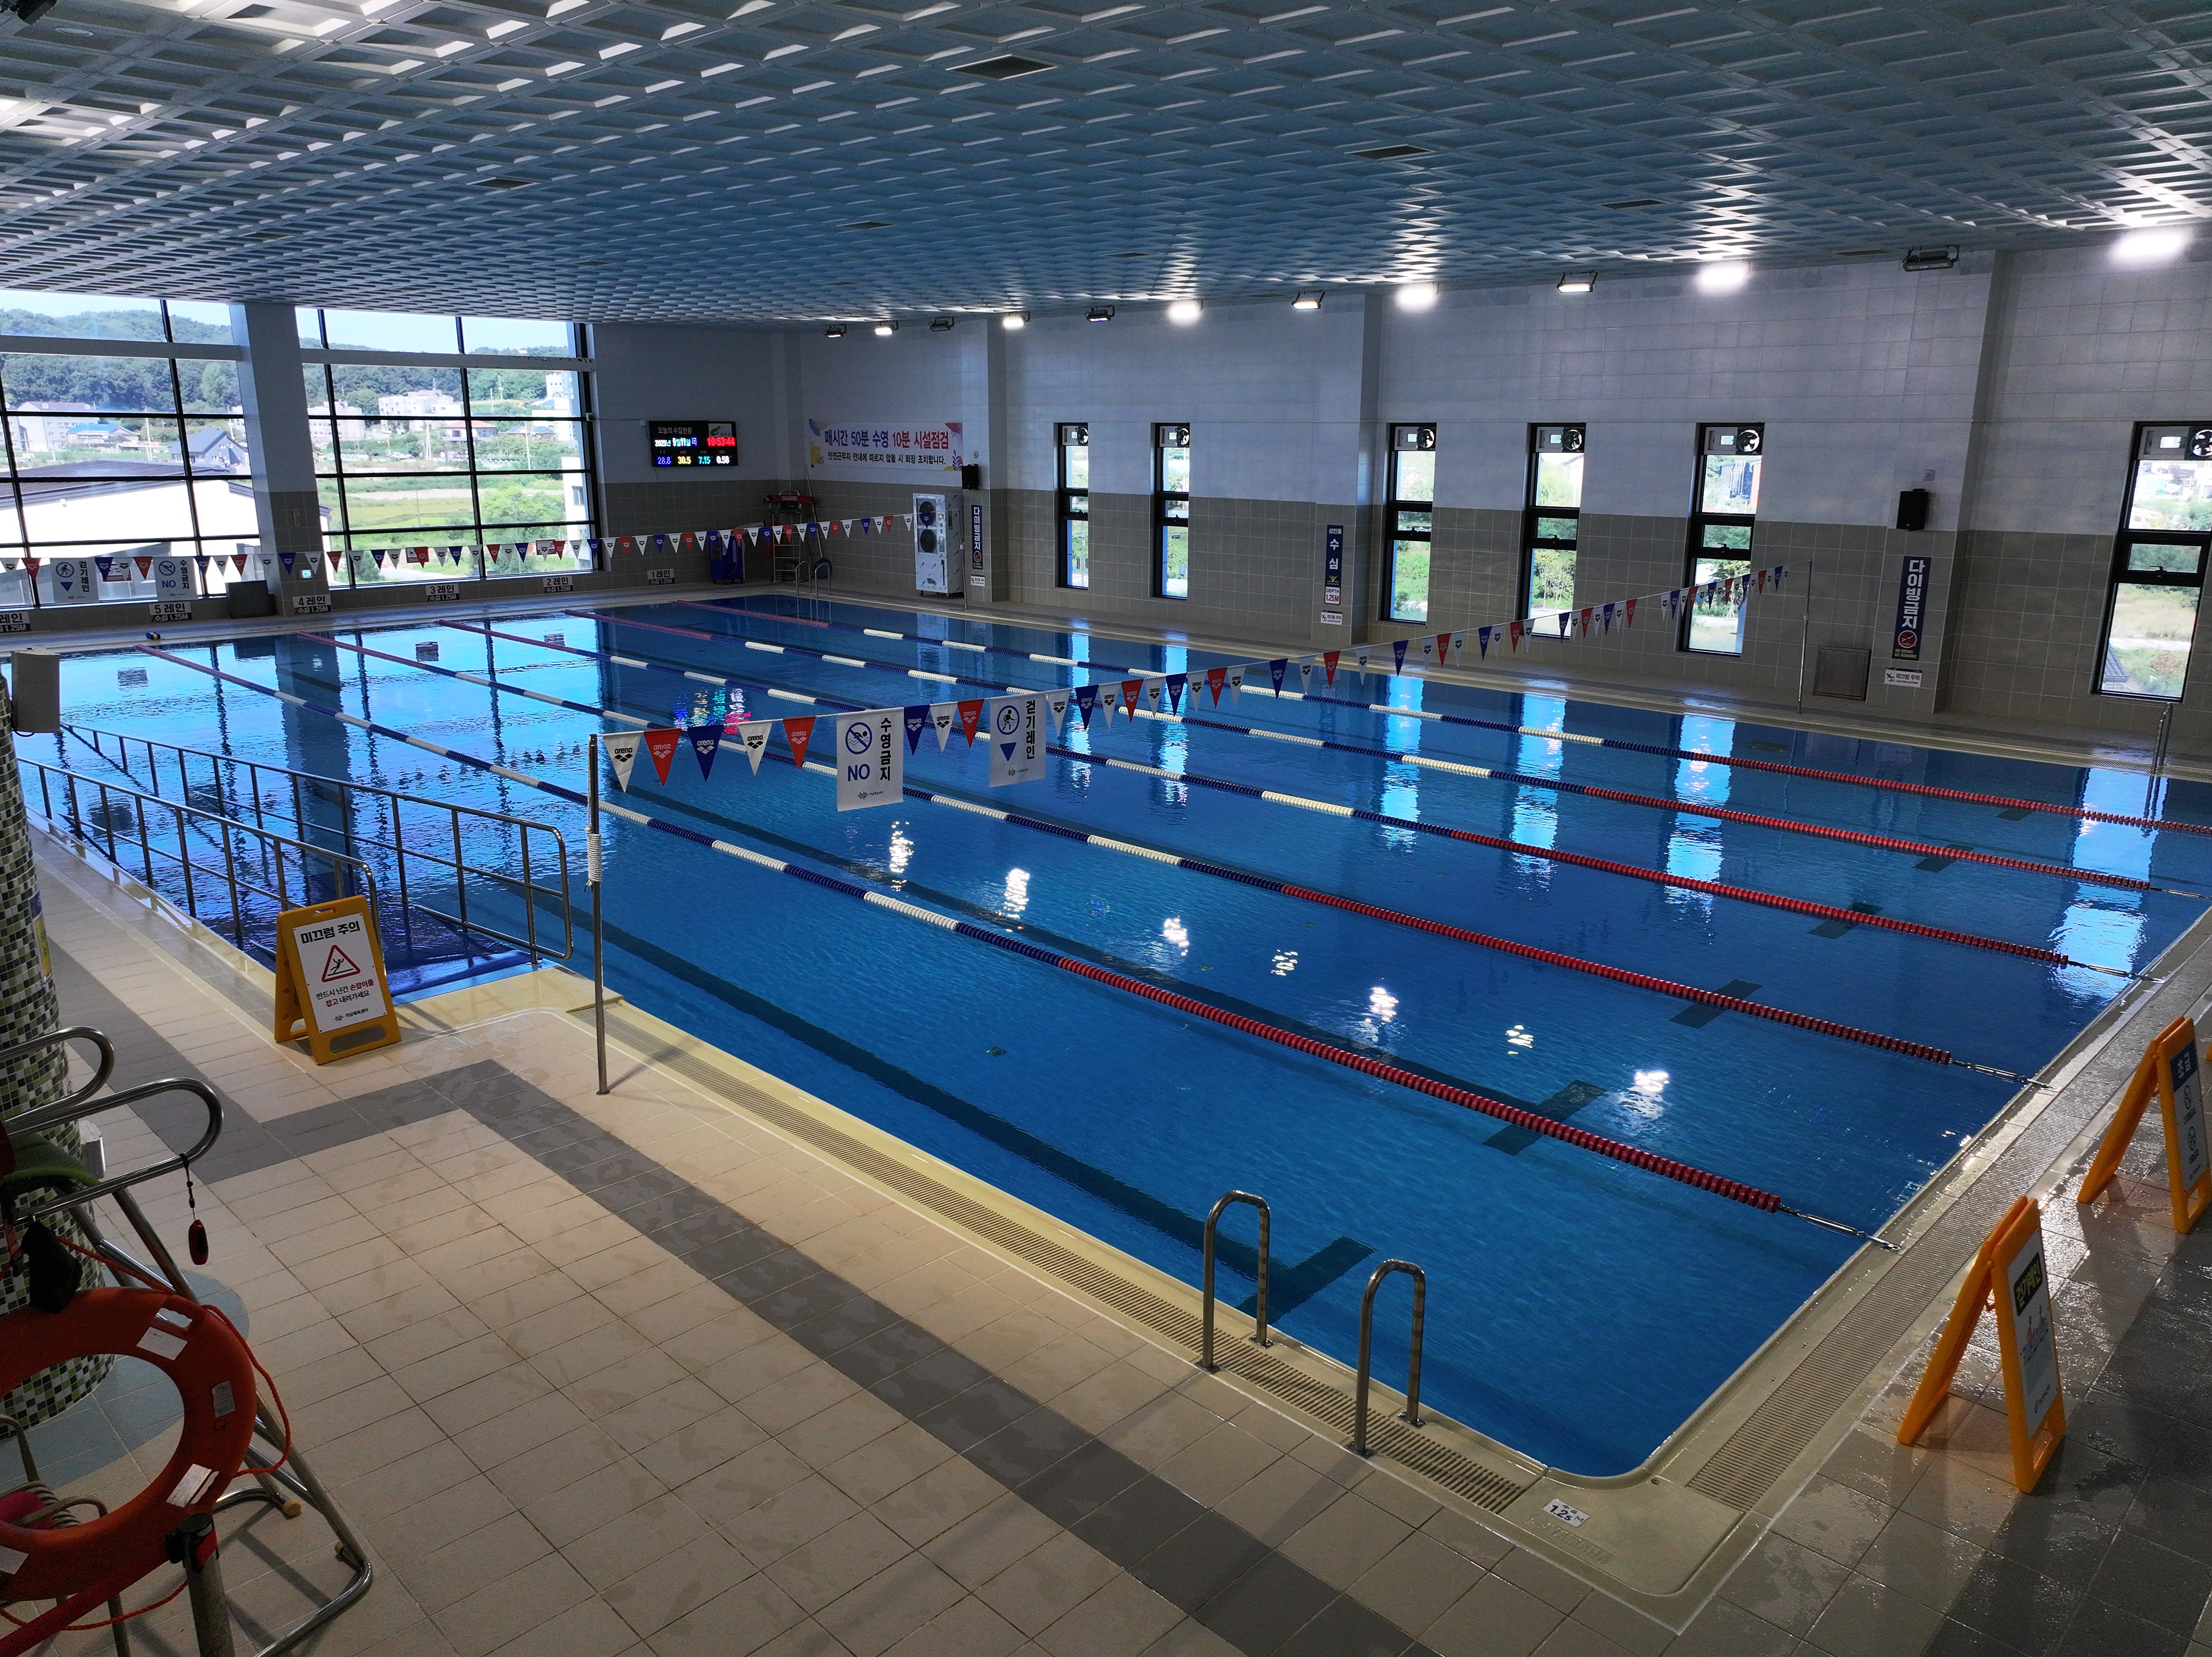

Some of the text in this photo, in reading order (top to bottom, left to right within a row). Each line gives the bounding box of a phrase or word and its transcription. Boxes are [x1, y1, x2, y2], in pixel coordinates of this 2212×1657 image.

[707, 437, 735, 447] 10:53:44
[824, 429, 949, 449] 매시간 50분 수영 10분 시설점검
[677, 456, 691, 464] 30.5
[698, 456, 711, 465] 7.15
[716, 456, 730, 464] 0.58
[828, 452, 946, 465] 안전근무자 안내에 따르지 않을 시 퇴장 조치합니다.
[79, 560, 89, 592] 걷기레인
[180, 559, 190, 589] 수영금지
[553, 577, 569, 585] 레인
[437, 585, 455, 593] 레인
[1902, 560, 1925, 629] 다이빙금지
[155, 603, 186, 614] 5 레인
[306, 596, 326, 605] 레인
[1026, 700, 1036, 759] 걷기레인
[880, 718, 892, 781] 수영금지
[848, 764, 870, 782] NO
[300, 921, 360, 944] 미끄럼 주의
[316, 979, 374, 1000] 반드시 난간 손잡이를
[325, 990, 370, 1007] 잡고 내려가세요
[1550, 1505, 1572, 1521] 1.25
